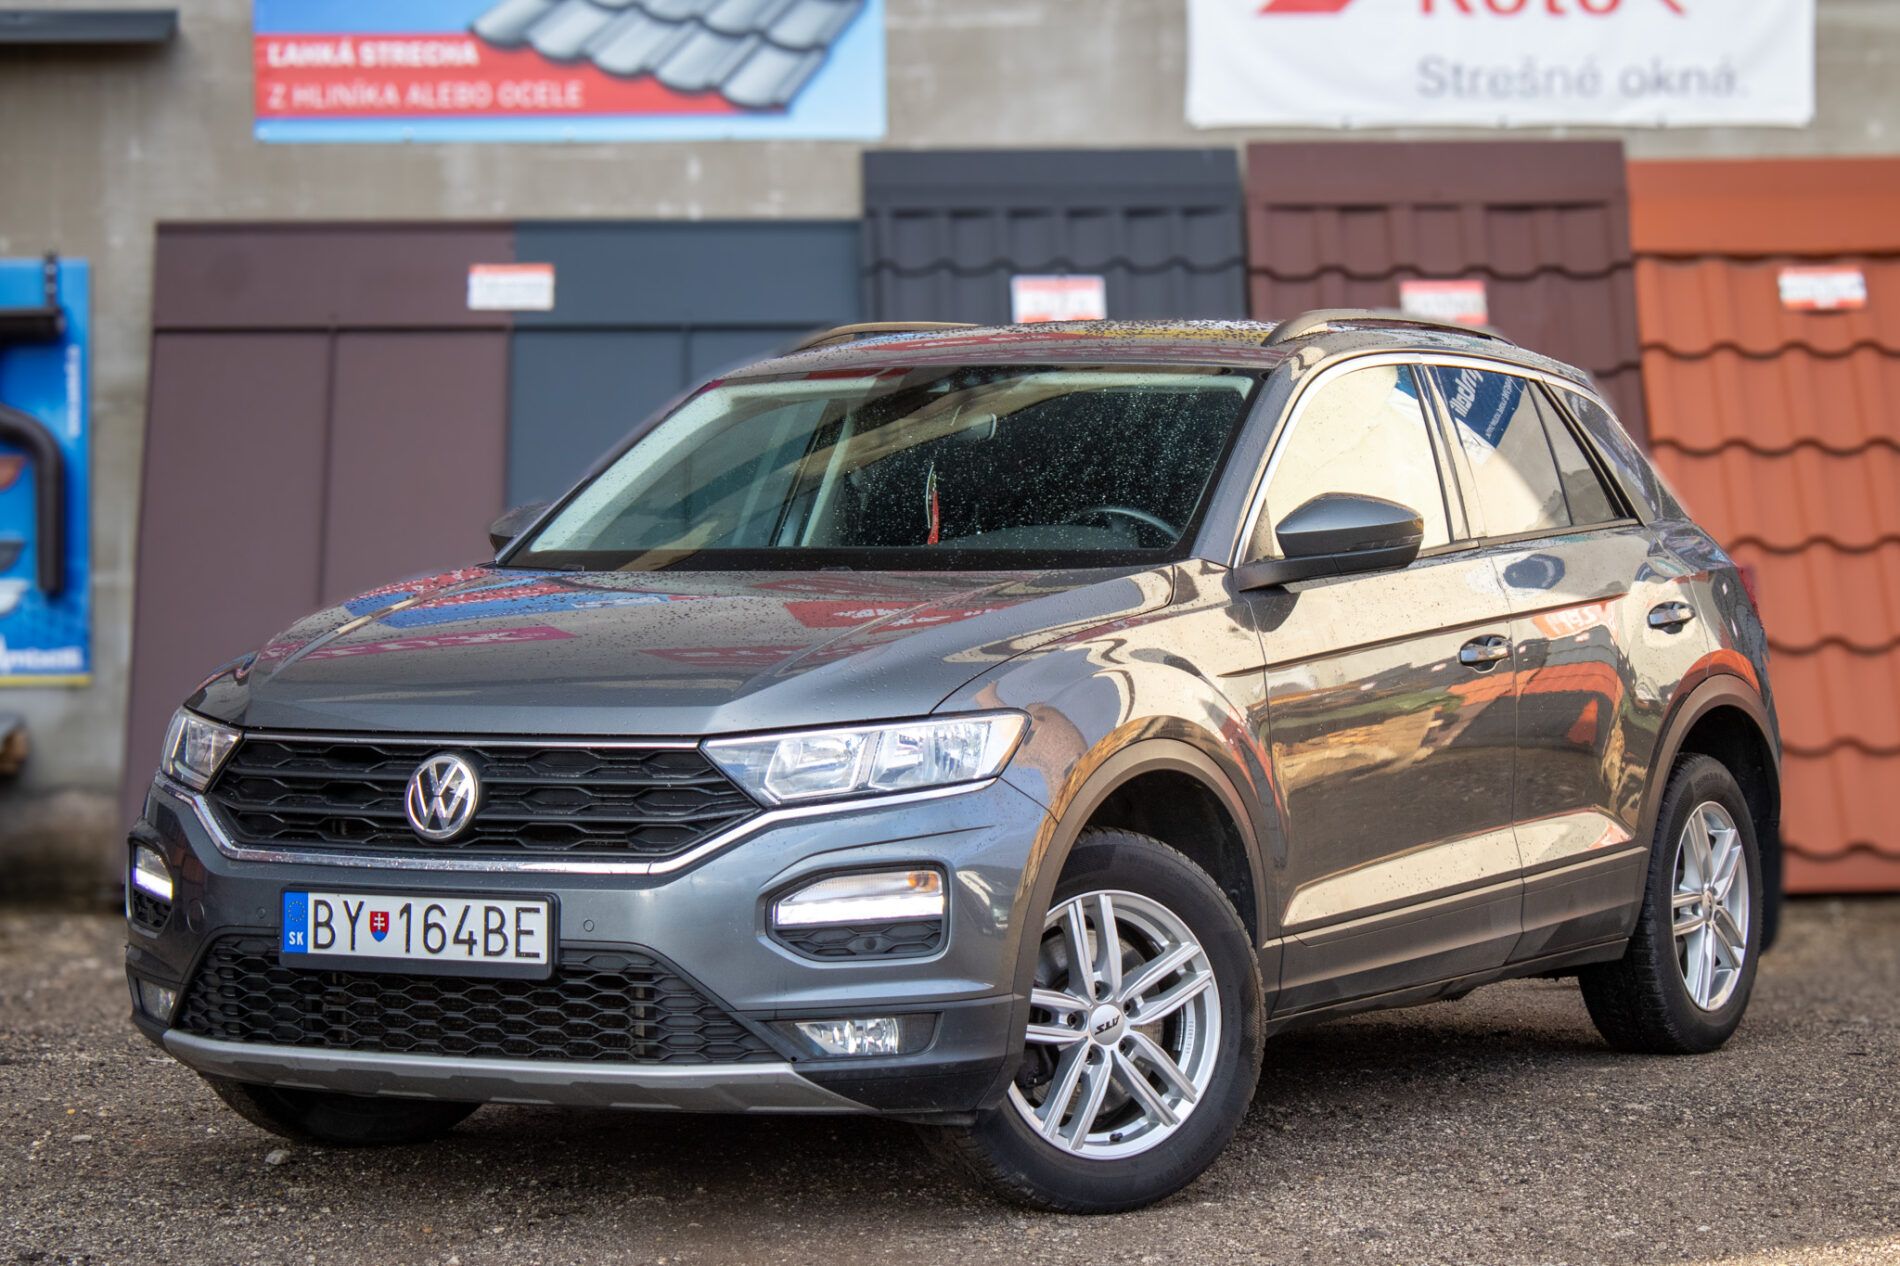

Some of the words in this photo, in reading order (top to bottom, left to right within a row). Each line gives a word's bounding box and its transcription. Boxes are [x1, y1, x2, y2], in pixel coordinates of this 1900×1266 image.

[361, 41, 480, 67] STRECHA
[1415, 53, 1603, 98] Strešné
[267, 82, 286, 109] Z
[292, 77, 400, 109] HLINÍKA
[405, 80, 493, 108] ALEBO
[498, 80, 582, 108] OCELE
[288, 931, 304, 946] SK
[313, 899, 365, 951] BY
[399, 902, 541, 958] 164BE
